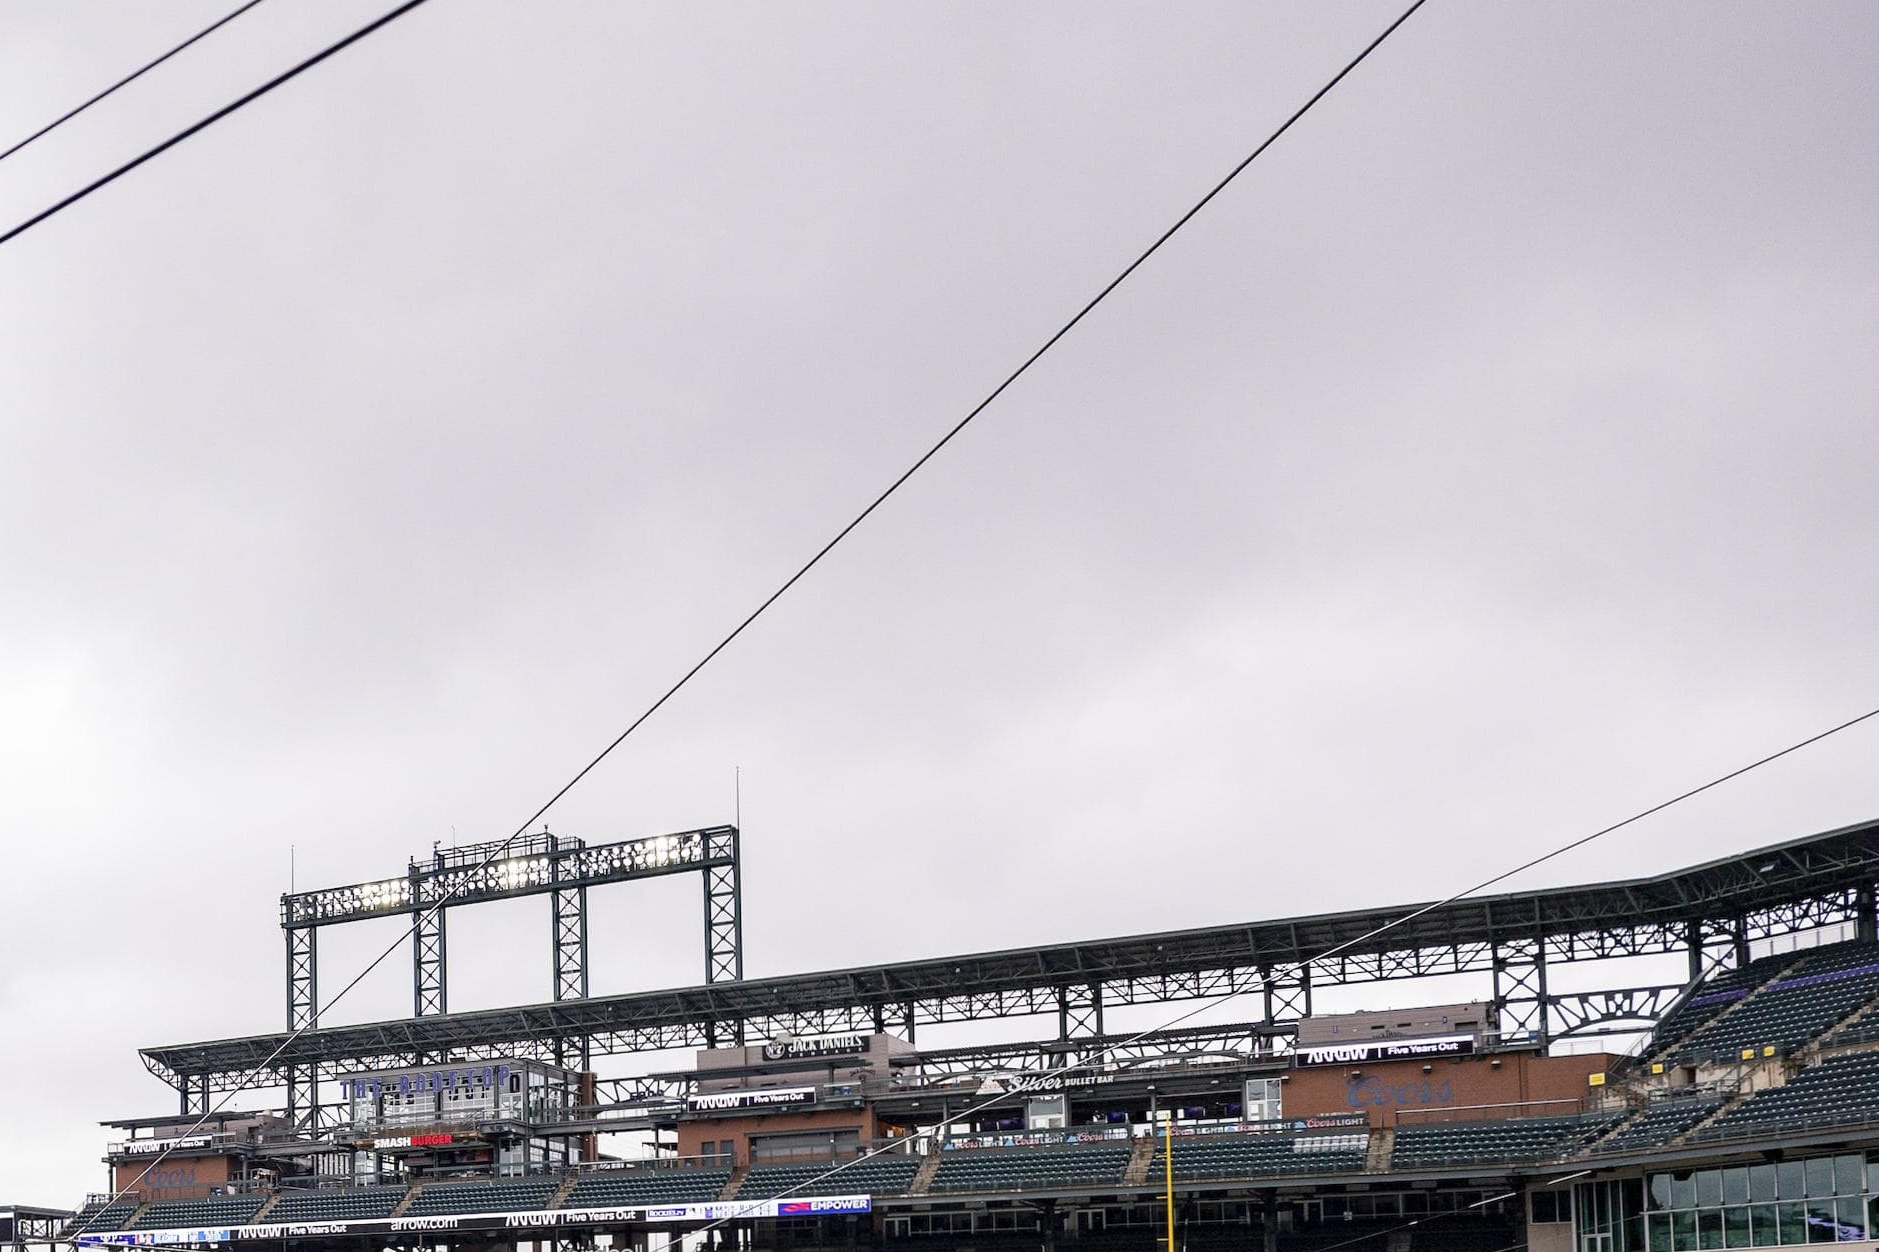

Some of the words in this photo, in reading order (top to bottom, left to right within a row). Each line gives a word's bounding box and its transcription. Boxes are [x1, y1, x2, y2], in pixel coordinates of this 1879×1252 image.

[787, 1039, 817, 1053] JACK
[1307, 1049, 1368, 1063] ARROW
[1387, 1046, 1408, 1055] Five
[1410, 1045, 1438, 1054] Years
[1438, 1042, 1459, 1050] Out
[340, 1077, 382, 1099] THE
[399, 1065, 510, 1095] ROOFTOP
[1007, 1075, 1063, 1092] Silver
[1065, 1076, 1095, 1087] BULLET
[1097, 1075, 1114, 1084] BAR
[1347, 1076, 1453, 1108] Coors
[1337, 1117, 1364, 1126] LIGHT
[374, 1135, 453, 1149] SMASHBURGER
[810, 1200, 868, 1211] EMPOWER
[390, 1217, 458, 1231] arrow.com
[506, 1213, 558, 1226] ARROW
[567, 1212, 587, 1222] Five
[588, 1211, 614, 1222] Years
[616, 1210, 636, 1220] Out
[238, 1225, 283, 1239] ARROW
[289, 1225, 305, 1235] Five
[306, 1225, 329, 1235] Years
[331, 1224, 347, 1233] Out
